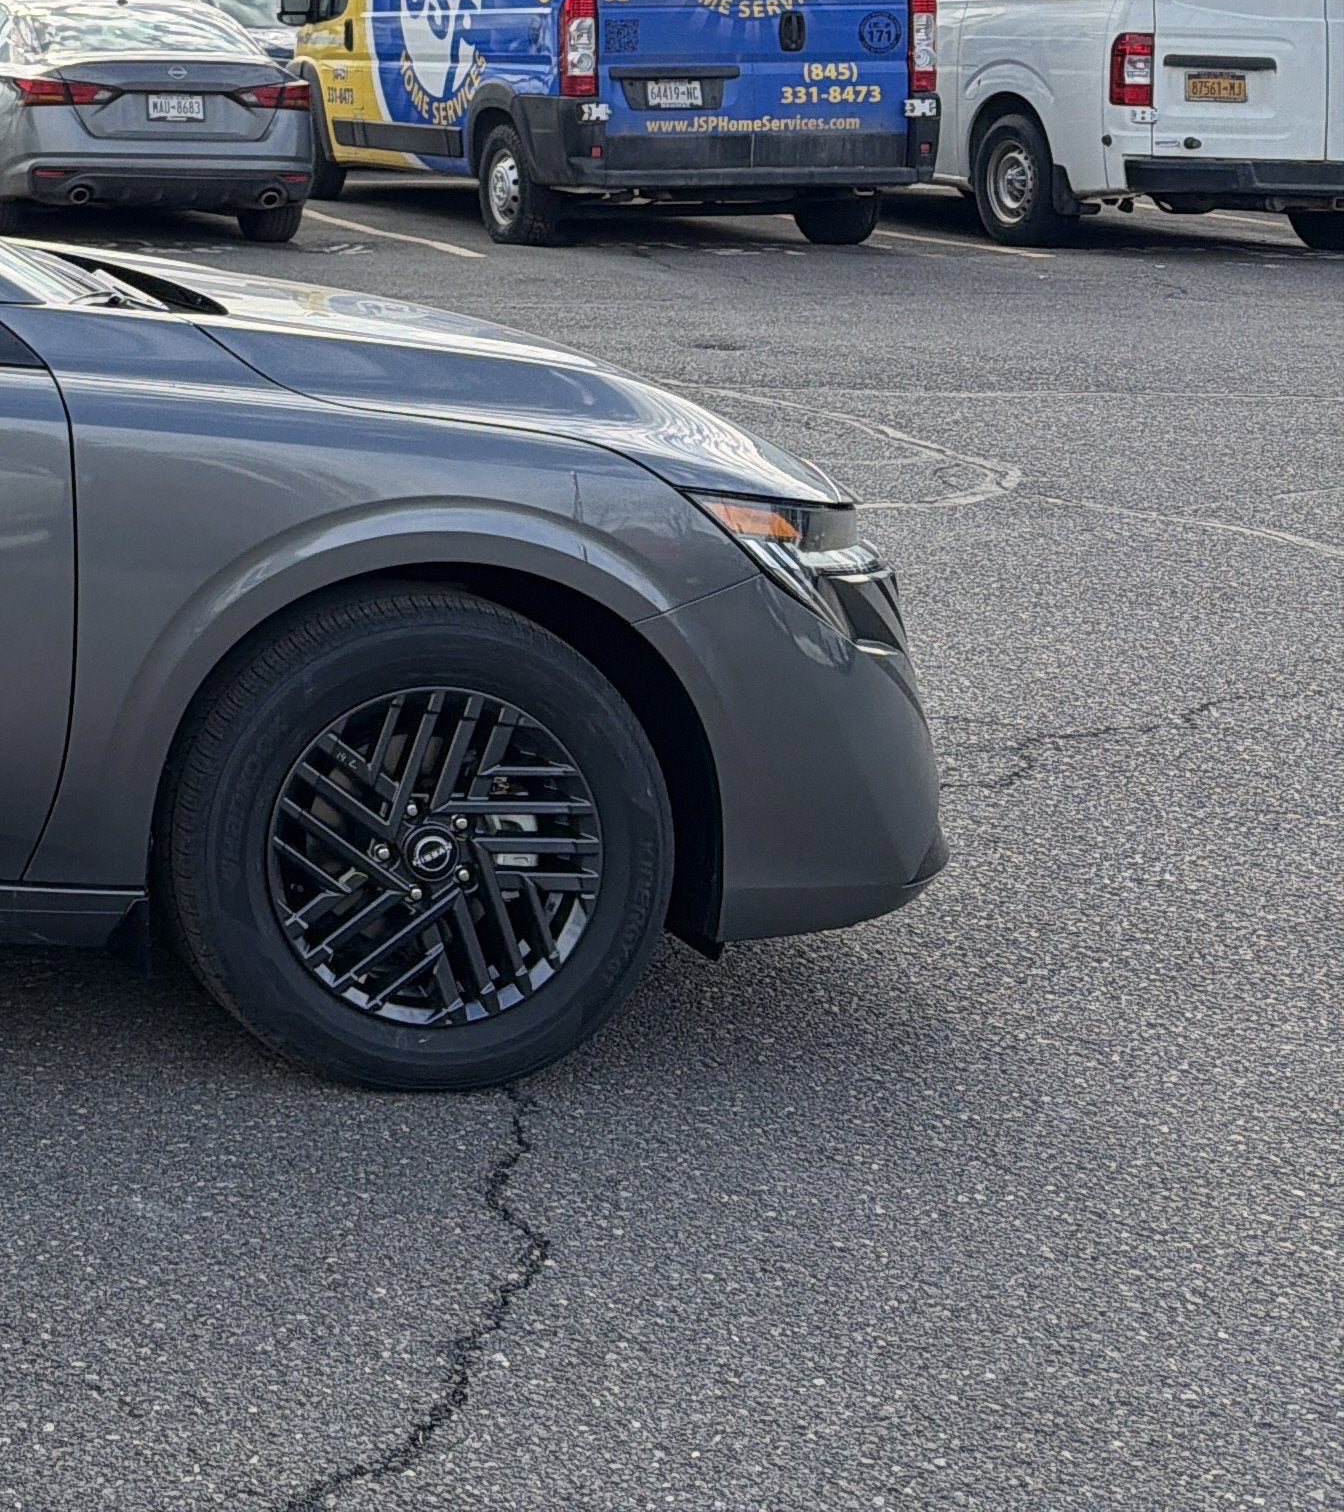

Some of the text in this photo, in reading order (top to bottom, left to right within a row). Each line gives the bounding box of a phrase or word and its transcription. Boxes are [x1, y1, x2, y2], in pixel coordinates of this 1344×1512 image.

[867, 29, 892, 43] 171
[803, 62, 858, 82] (845)
[781, 85, 881, 104] 331-8473
[646, 115, 860, 133] www.JSPHomeServices.com
